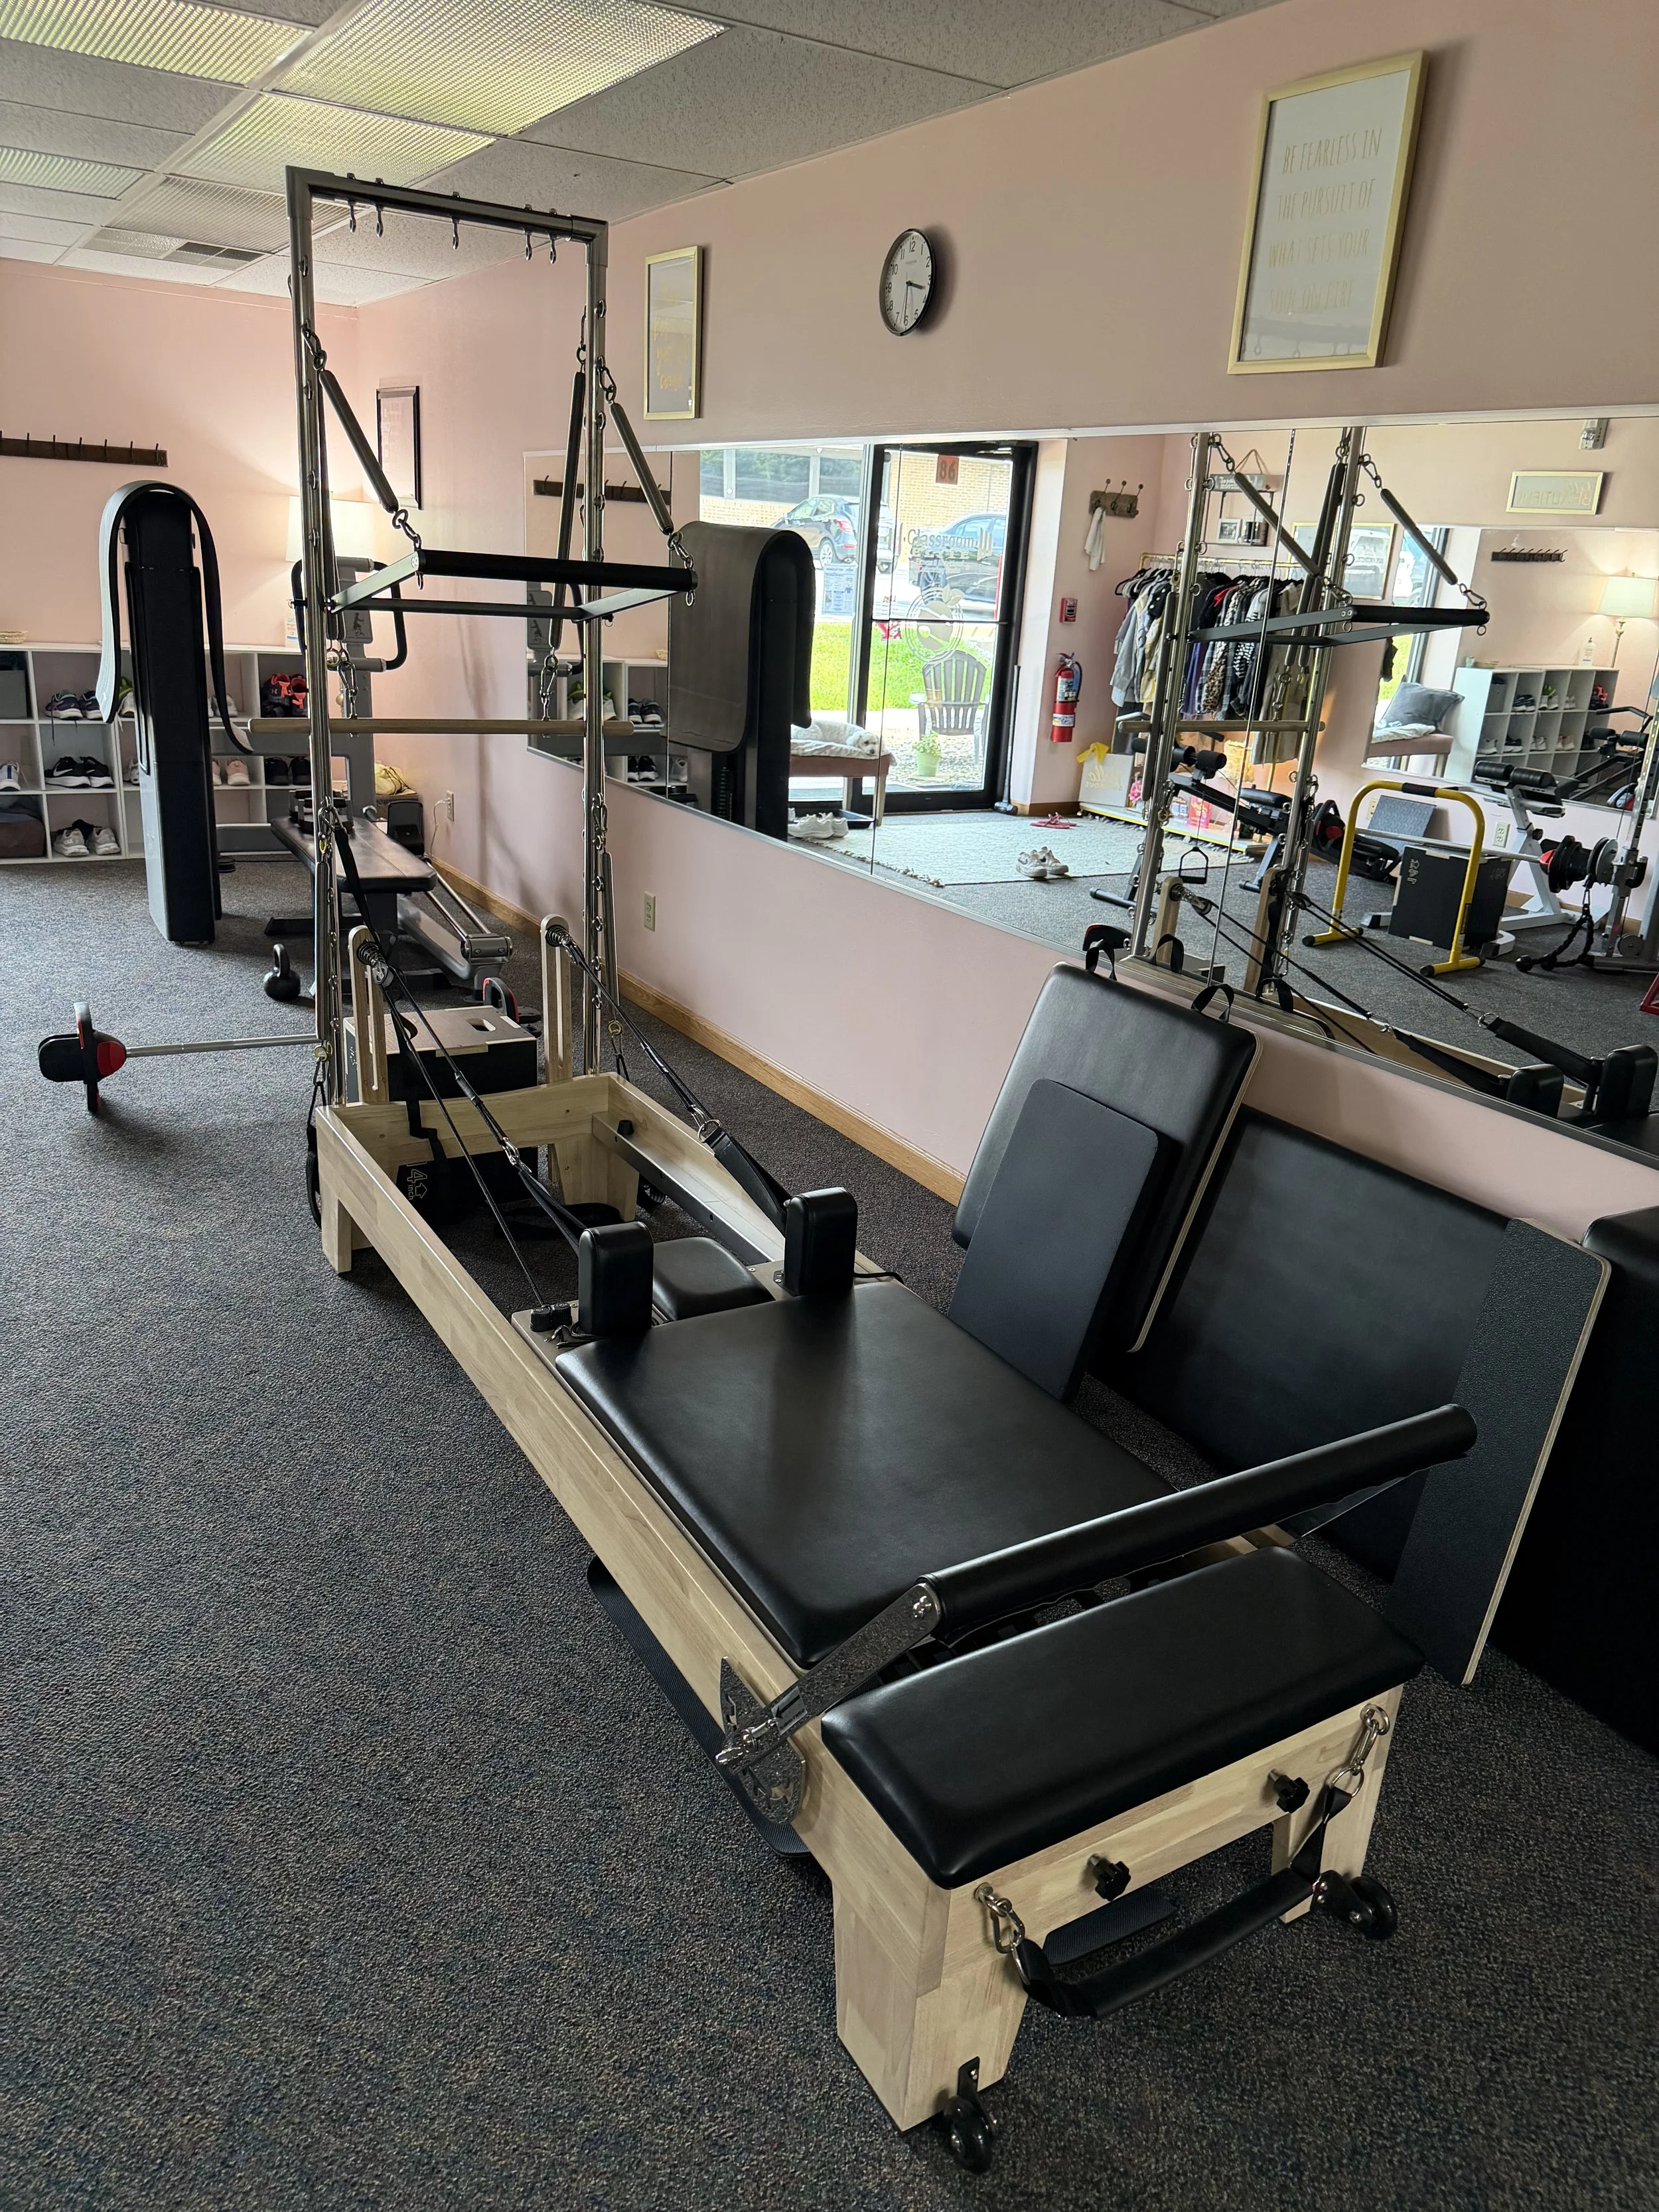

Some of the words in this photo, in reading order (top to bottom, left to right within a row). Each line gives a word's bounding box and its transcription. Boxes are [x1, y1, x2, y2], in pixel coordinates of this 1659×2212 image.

[1283, 143, 1297, 175] BE
[1299, 132, 1358, 172] FEARLESS
[1362, 127, 1383, 161] IN
[1277, 192, 1297, 222] THE
[1300, 182, 1356, 218] PURSUIT
[1359, 177, 1377, 209] OF
[909, 241, 916, 253] 12
[1268, 237, 1301, 269] WHAT
[1306, 232, 1332, 265] SETS
[1338, 228, 1370, 259] YOUR
[901, 248, 905, 260] 11
[926, 256, 930, 267] 2
[892, 263, 899, 275] 10
[888, 281, 892, 293] 9
[889, 301, 894, 311] 8
[895, 312, 900, 323] 7
[914, 309, 919, 320] 5
[904, 315, 908, 327] 6
